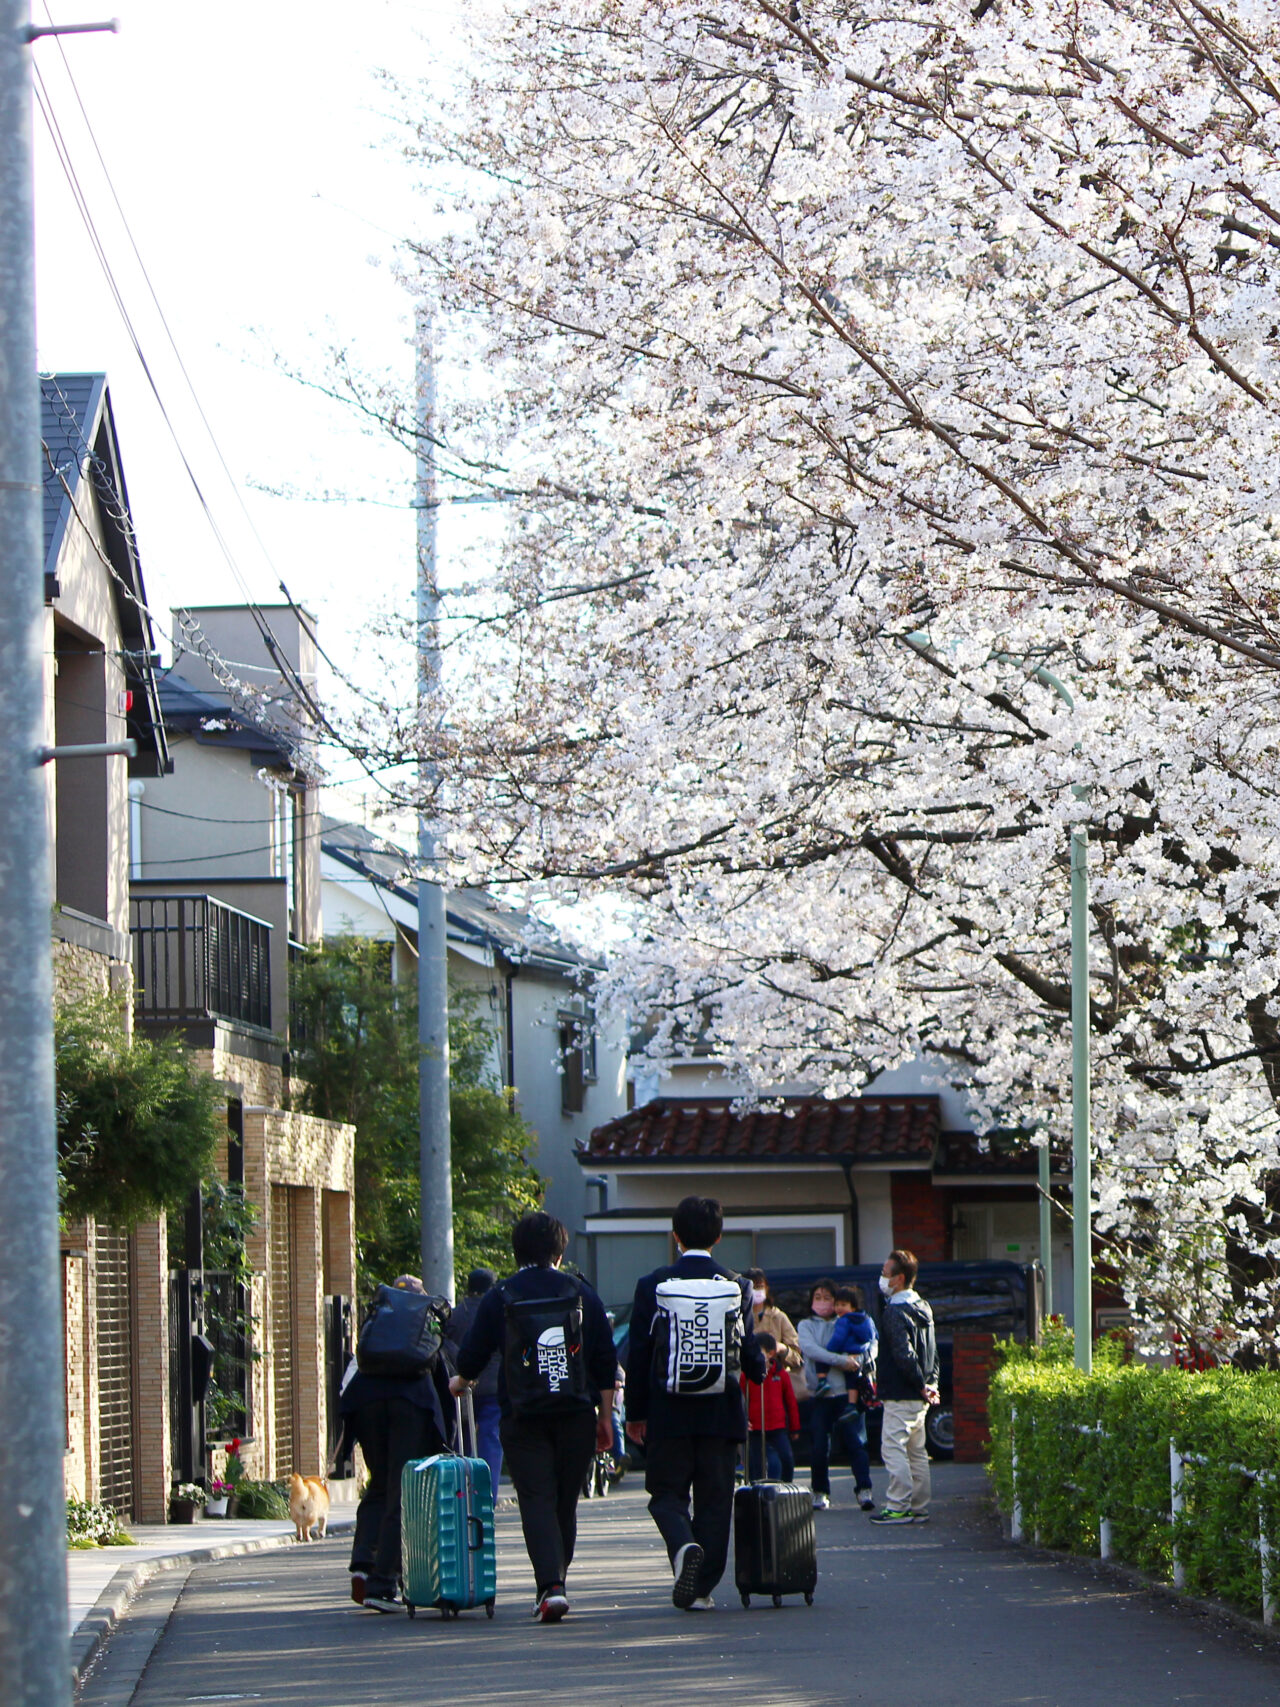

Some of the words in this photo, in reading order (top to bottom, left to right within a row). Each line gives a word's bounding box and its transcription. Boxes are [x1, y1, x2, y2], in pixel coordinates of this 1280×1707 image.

[680, 1319, 694, 1362] FACE
[694, 1302, 709, 1363] NORTH
[709, 1328, 723, 1363] THE
[538, 1348, 549, 1375] THE
[547, 1349, 561, 1392] NORTH
[557, 1348, 569, 1379] FACE
